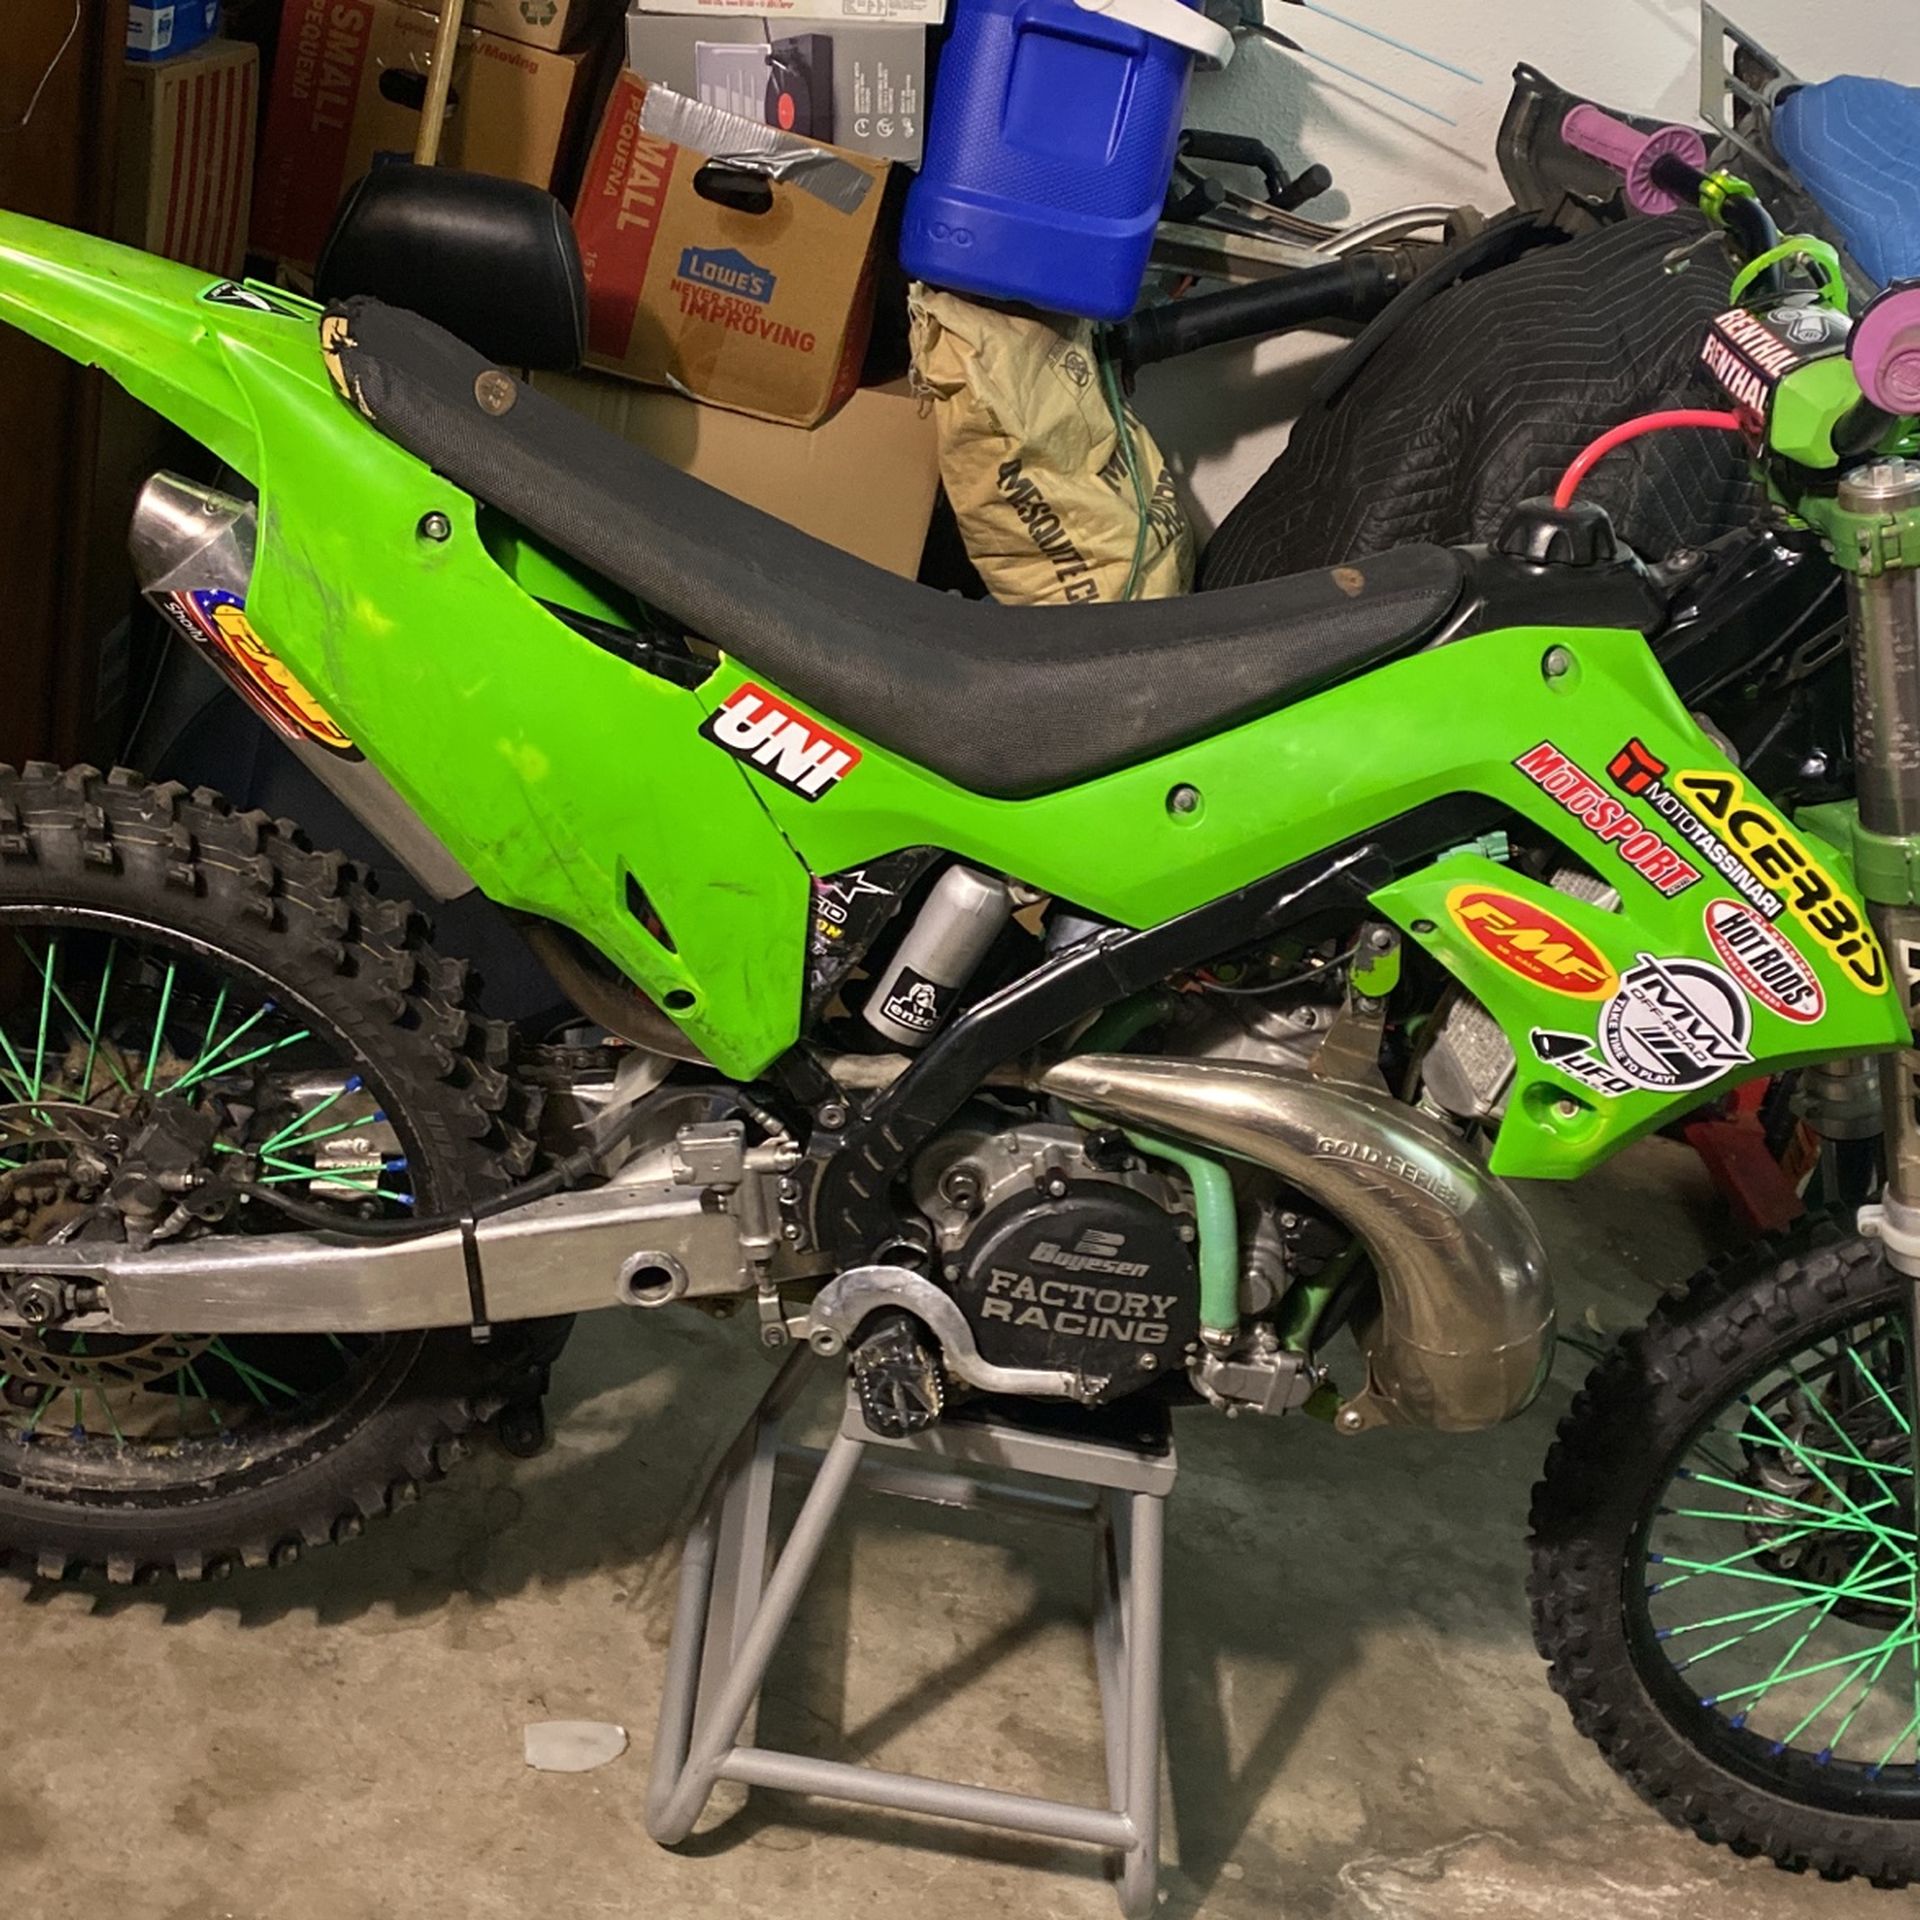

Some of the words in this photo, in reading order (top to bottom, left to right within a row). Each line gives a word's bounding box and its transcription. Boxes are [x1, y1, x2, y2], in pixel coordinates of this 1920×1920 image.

[310, 4, 364, 133] SMALL
[616, 133, 669, 230] MALL
[670, 279, 721, 304] NEVER
[724, 296, 763, 316] STOP
[689, 254, 765, 296] LOWE'S
[680, 295, 816, 353] IMPROVING
[1714, 308, 1799, 378] RENTHAL
[1701, 334, 1769, 416] RENTHAL
[713, 693, 851, 797] UNI
[1645, 782, 1784, 918] MOTOTASSINARI
[1456, 901, 1611, 983] FMF
[1714, 911, 1771, 956] HOT
[1747, 946, 1815, 1006] RODS
[1608, 998, 1628, 1030] TAKE
[1630, 987, 1708, 1062] OFF-ROAD
[1562, 1055, 1634, 1092] UFO
[1608, 1031, 1626, 1061] TIME
[1623, 1057, 1640, 1074] TO
[1639, 1069, 1676, 1084] PLAY!
[1318, 1139, 1382, 1163] GOLD
[1385, 1156, 1457, 1205] SERIES
[980, 1296, 1170, 1344] RACING
[987, 1268, 1178, 1319] FACTORY
